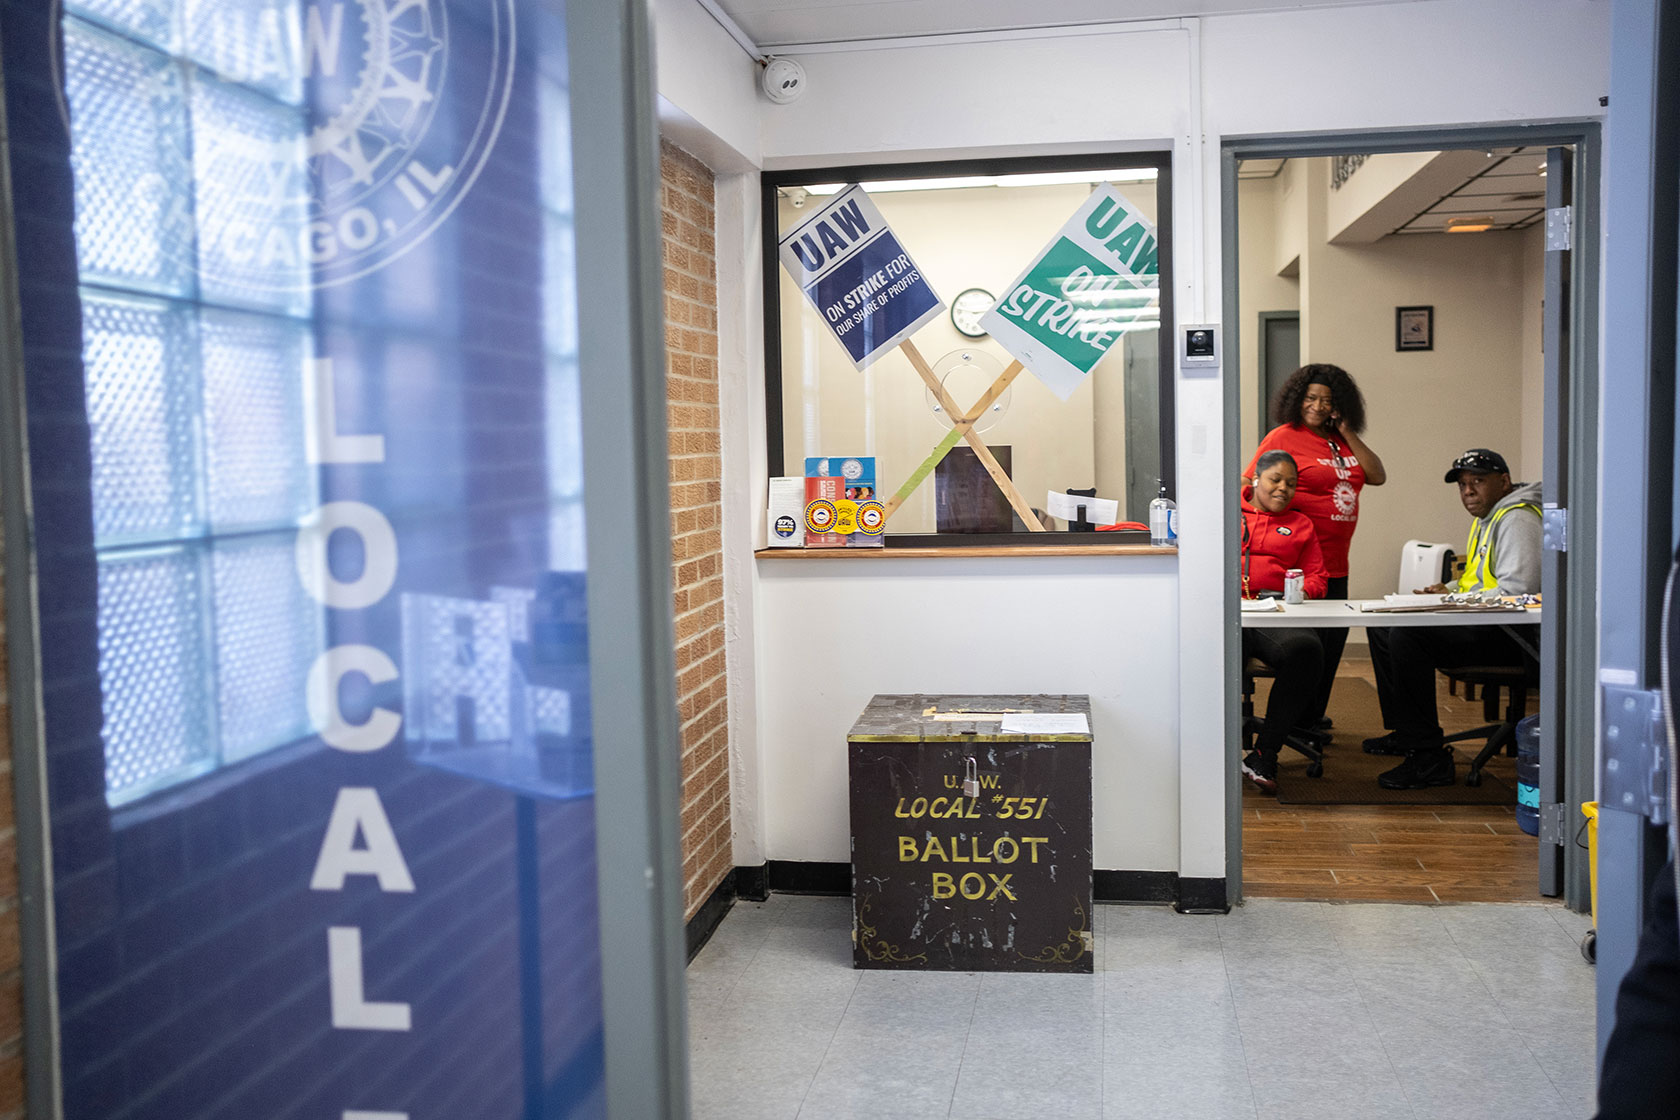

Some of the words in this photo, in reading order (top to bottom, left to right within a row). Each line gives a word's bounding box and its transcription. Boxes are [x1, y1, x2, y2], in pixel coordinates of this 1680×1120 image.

[131, 172, 398, 265] CHCAGO,
[394, 160, 454, 210] IL
[790, 198, 870, 272] UAW
[826, 301, 846, 322] ON
[843, 270, 888, 309] STRIKE
[885, 253, 911, 279] FOR
[836, 317, 854, 336] OUR
[855, 300, 880, 324] SHARE
[877, 292, 889, 306] OF
[889, 270, 920, 300] PROFITS
[1061, 265, 1119, 306] ON
[1001, 284, 1113, 351] STRIKE
[1334, 468, 1352, 480] UP
[295, 356, 416, 1031] LOCAL
[895, 797, 981, 819] LOCAL
[992, 794, 1048, 820] #551
[944, 775, 1001, 789] U.W.
[898, 836, 1049, 864] BALLOT
[932, 872, 1018, 901] BOX
